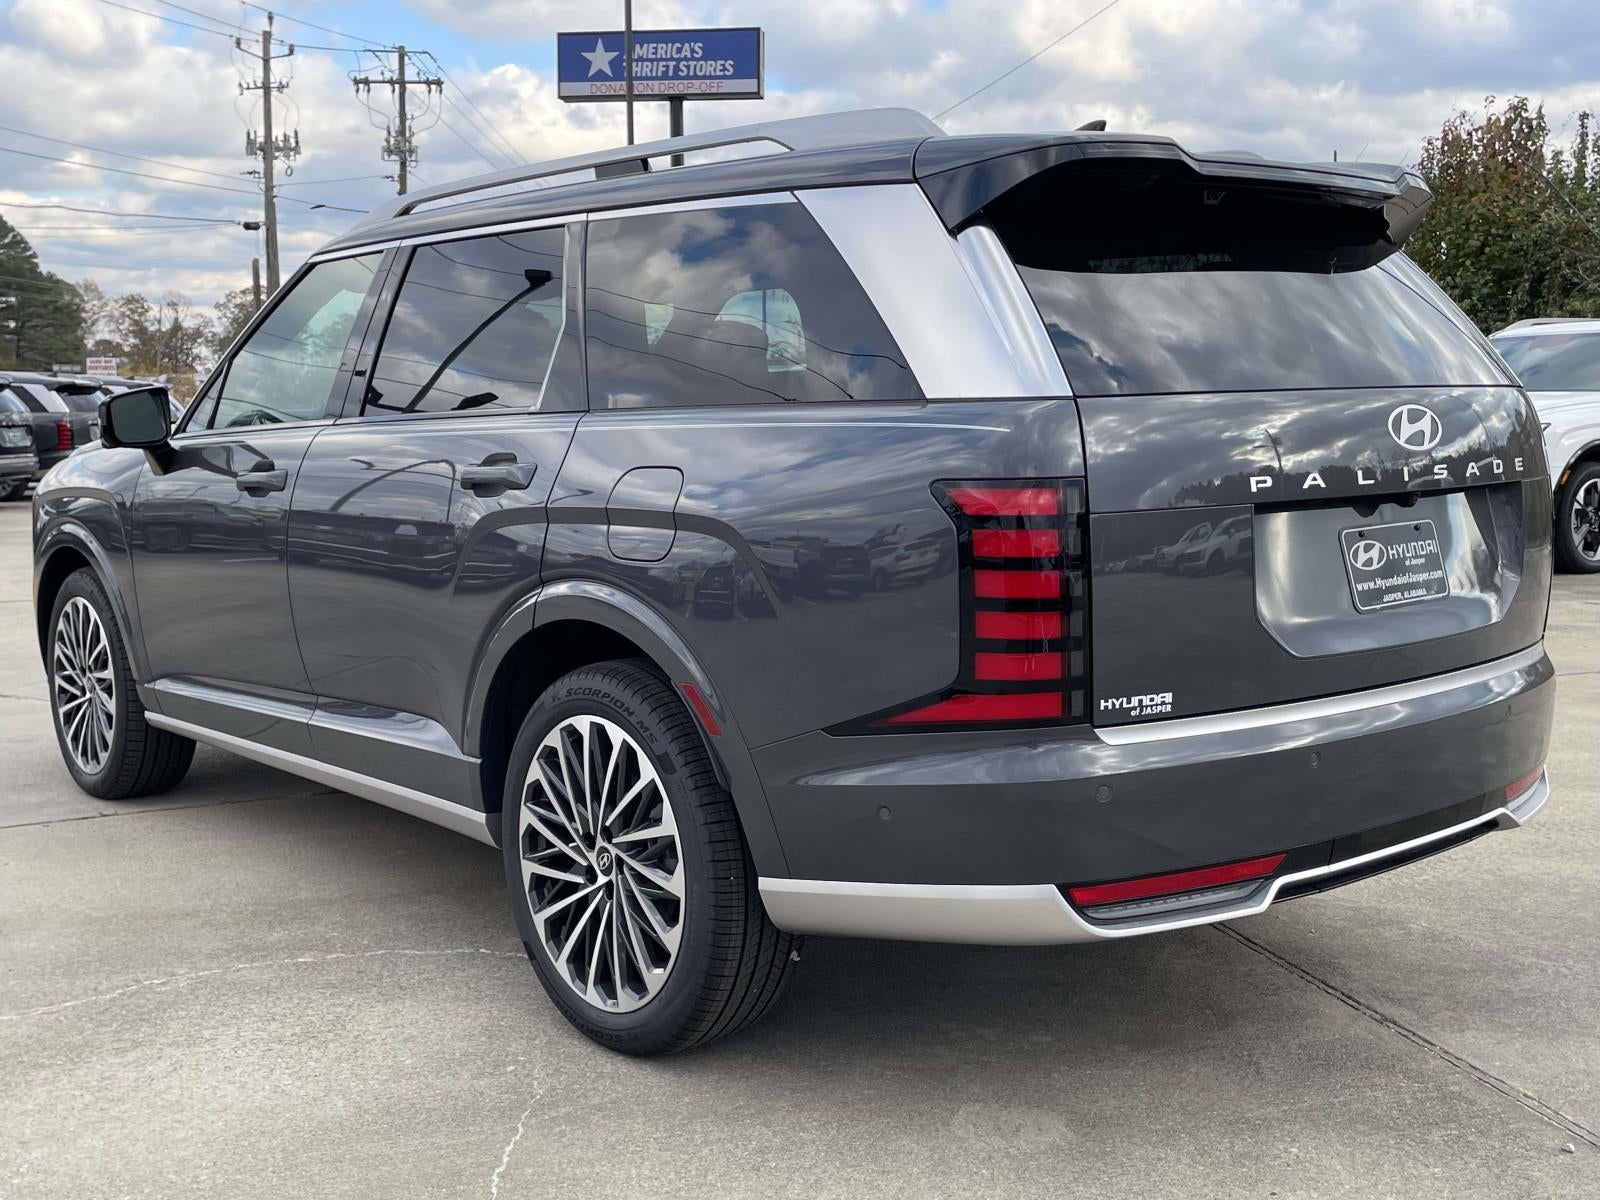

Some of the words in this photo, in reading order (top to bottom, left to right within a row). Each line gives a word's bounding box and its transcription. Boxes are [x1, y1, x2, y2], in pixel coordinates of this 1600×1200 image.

[678, 60, 734, 76] STORES
[590, 83, 654, 94] DONAON
[658, 82, 724, 92] DROP-OFF
[1249, 457, 1524, 493] PALISADE
[1388, 540, 1437, 559] HYUNDAI
[1383, 592, 1403, 602] JASPER,
[1404, 588, 1427, 598] ALABAMA
[564, 687, 635, 717] SCORPION
[1100, 692, 1173, 710] HYUNDAI
[1130, 707, 1140, 716] of
[1141, 704, 1172, 715] JASPER
